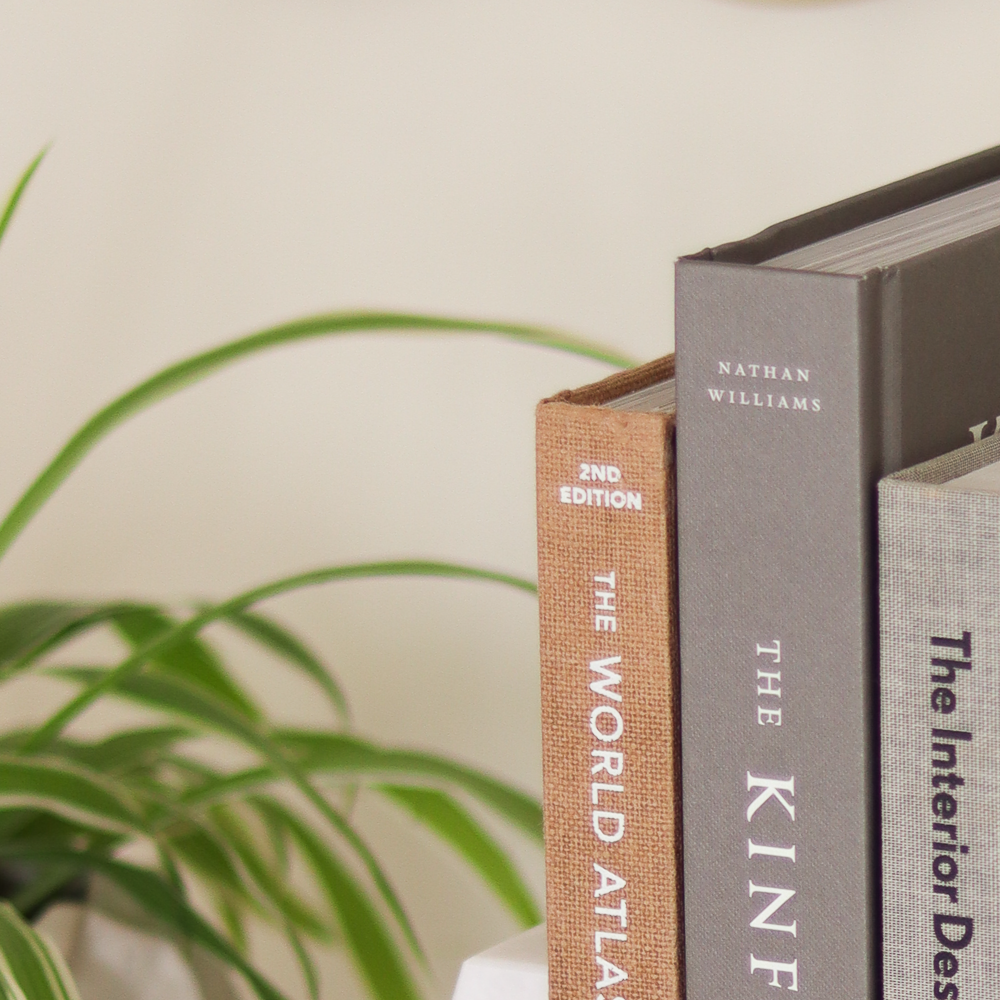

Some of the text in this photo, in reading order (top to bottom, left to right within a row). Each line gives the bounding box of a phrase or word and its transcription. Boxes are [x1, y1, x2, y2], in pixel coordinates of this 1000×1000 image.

[708, 389, 822, 412] WILLIAMS
[719, 361, 811, 382] NATHAN
[559, 486, 642, 511] EDITION
[579, 463, 622, 484] 2ND
[593, 571, 617, 633] THE
[756, 639, 782, 727] THE
[930, 630, 973, 715] The
[589, 655, 625, 843] WORLD
[930, 727, 974, 904] Interior
